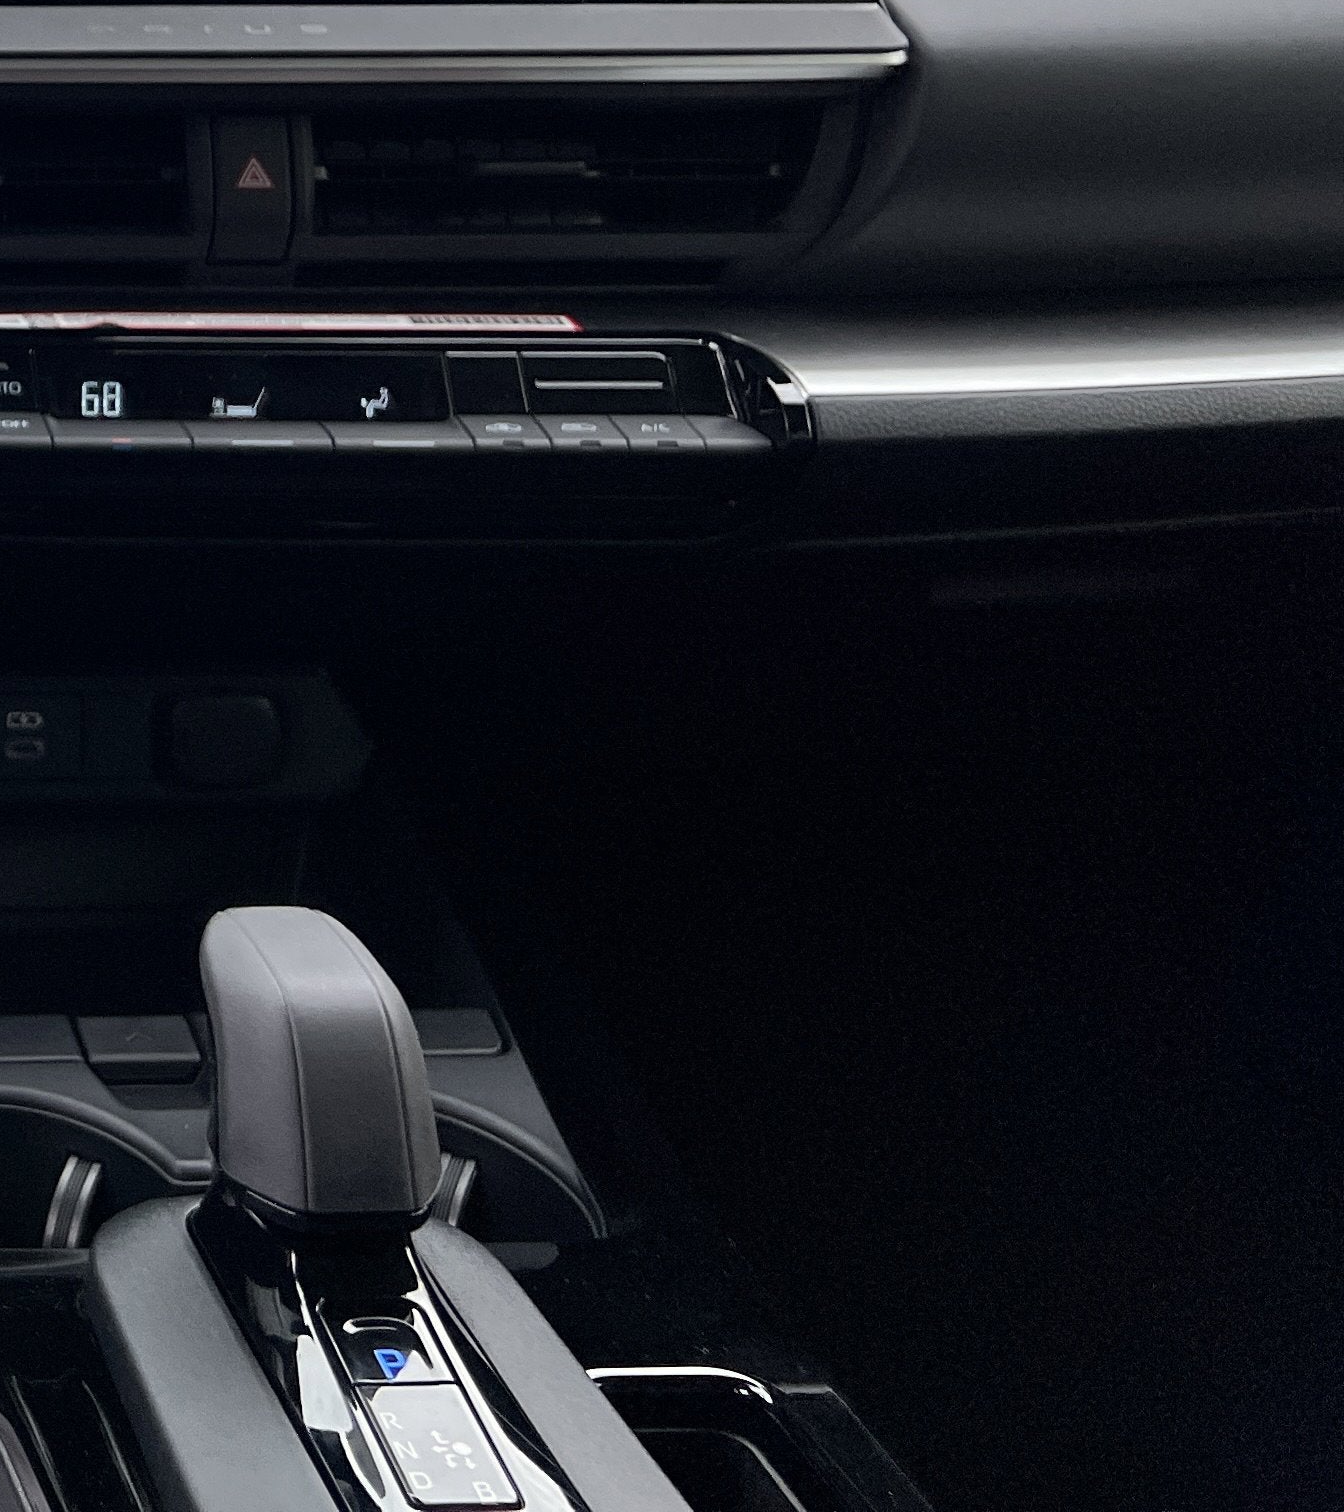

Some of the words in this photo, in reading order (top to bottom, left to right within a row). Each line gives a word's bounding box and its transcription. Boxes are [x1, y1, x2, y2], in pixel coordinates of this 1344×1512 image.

[373, 1348, 407, 1380] P
[379, 1412, 403, 1430] R
[396, 1441, 420, 1459] N
[408, 1472, 433, 1489] D
[472, 1481, 498, 1506] B
